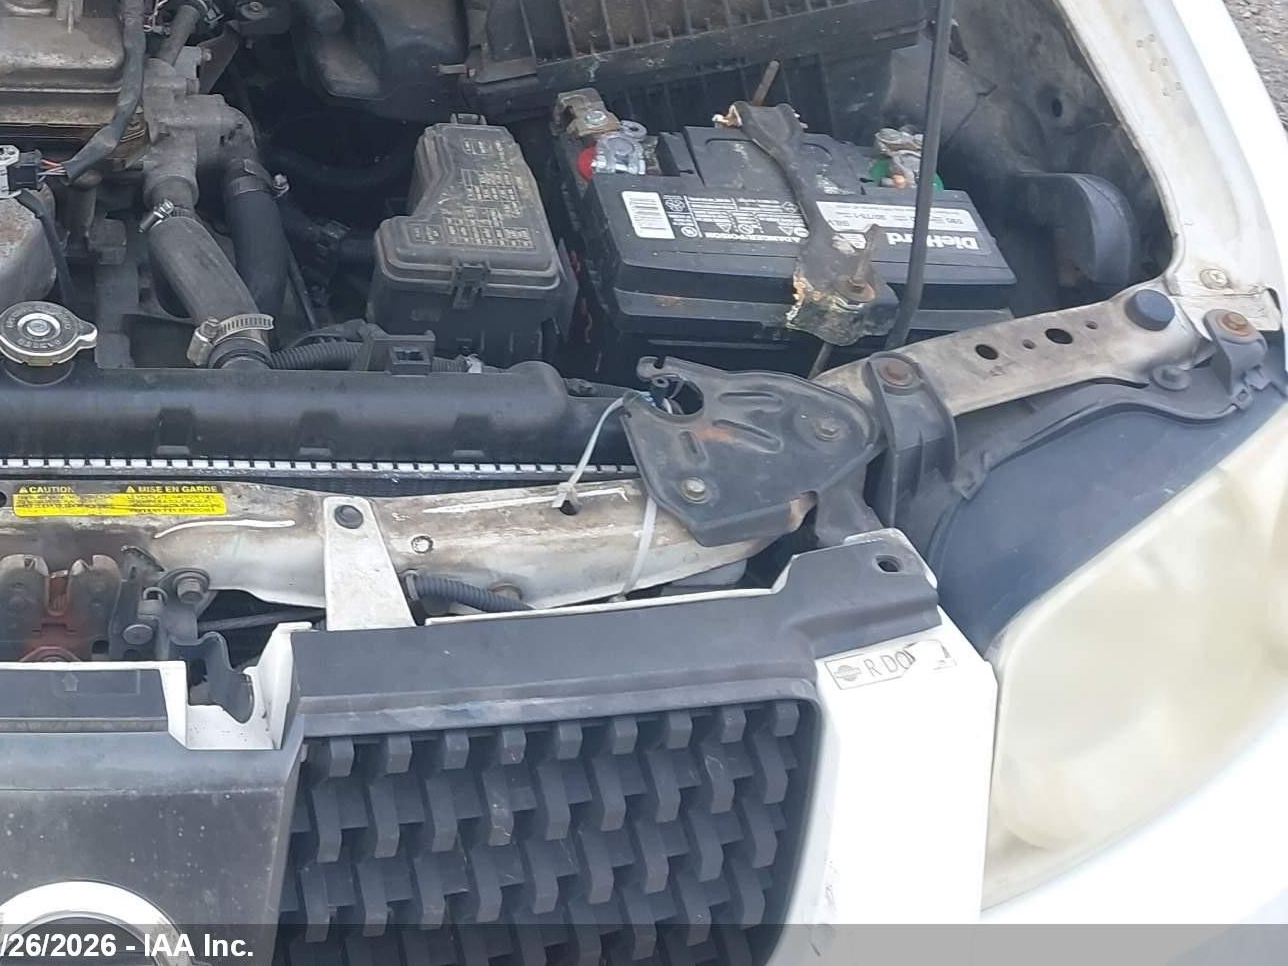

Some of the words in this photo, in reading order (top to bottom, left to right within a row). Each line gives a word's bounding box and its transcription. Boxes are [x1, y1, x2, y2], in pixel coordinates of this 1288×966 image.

[885, 232, 980, 250] DieHrd
[138, 485, 163, 493] MISE
[165, 485, 180, 493] EN
[181, 485, 219, 493] GARDE
[863, 658, 882, 677] R
[880, 648, 917, 673] DO
